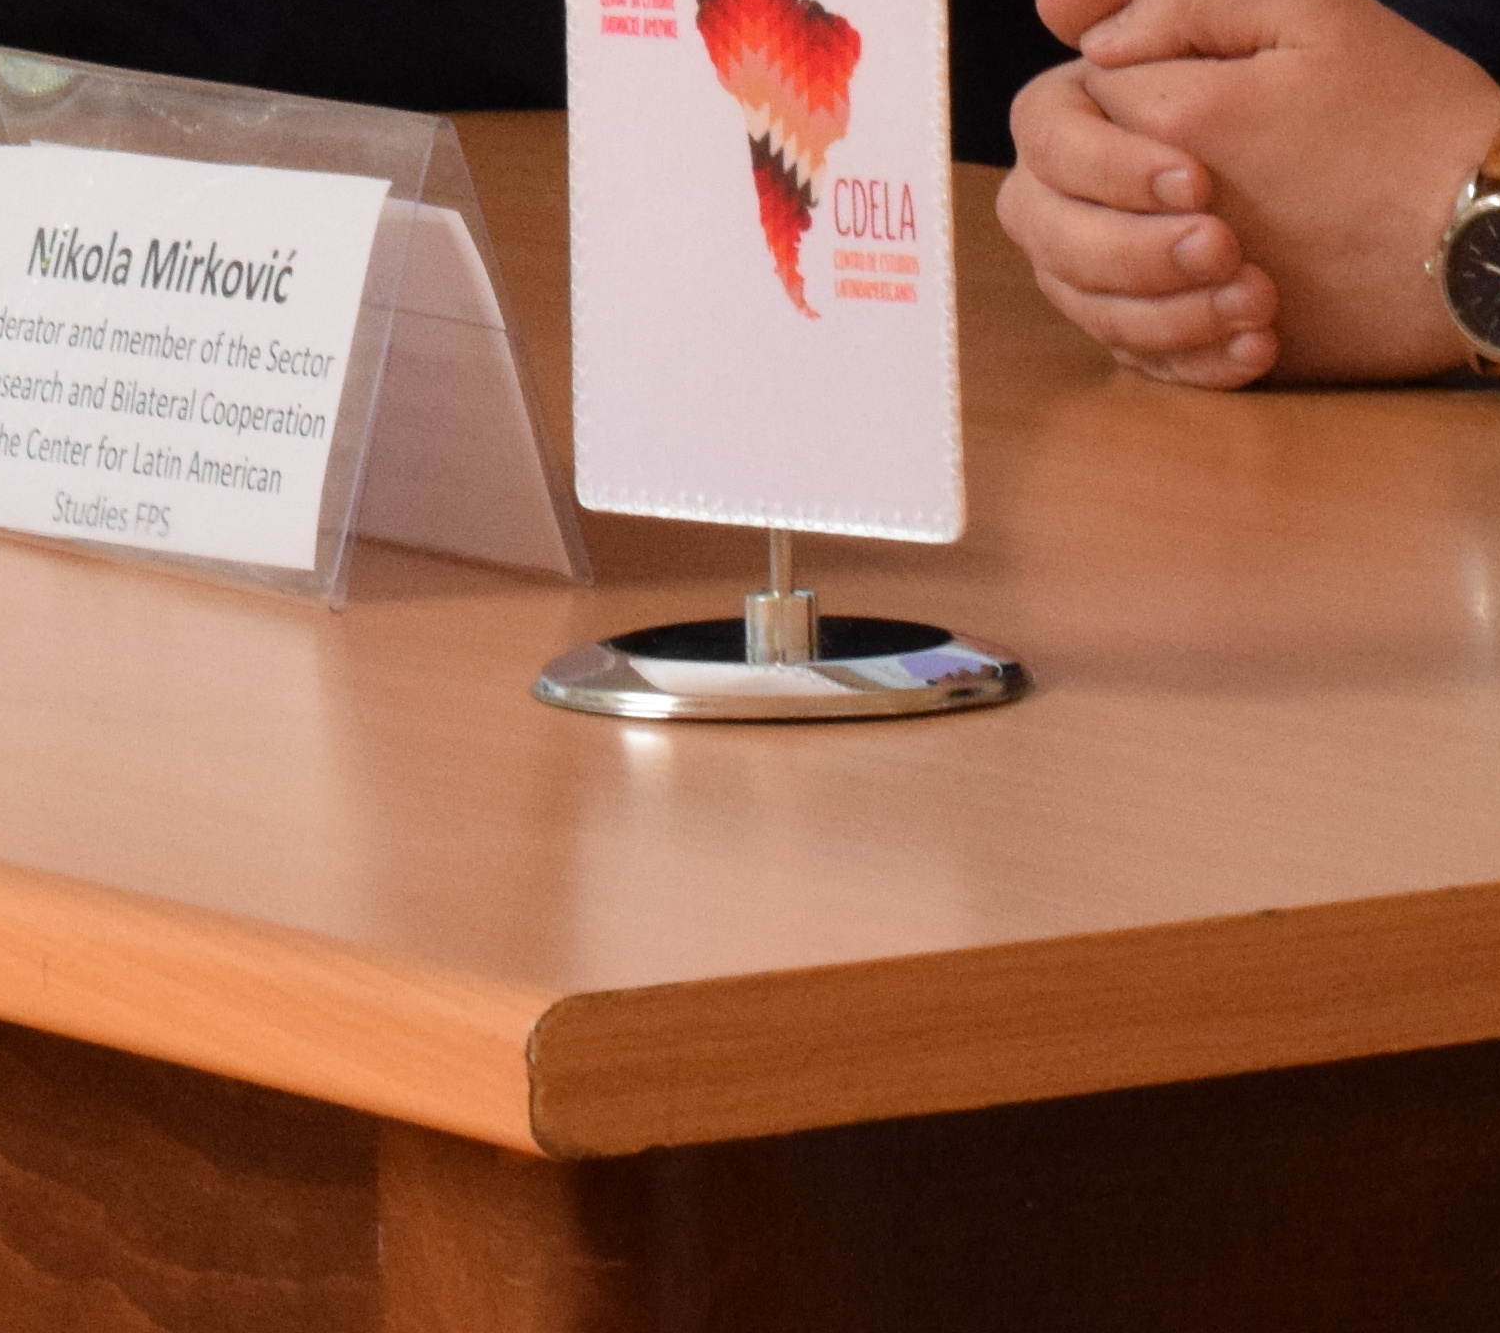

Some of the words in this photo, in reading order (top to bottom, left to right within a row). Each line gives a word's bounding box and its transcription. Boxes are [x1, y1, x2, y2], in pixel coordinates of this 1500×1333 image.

[835, 178, 917, 242] CDELA
[26, 227, 133, 287] Nikola
[140, 238, 297, 305] Mirković
[68, 317, 108, 351] and
[110, 325, 198, 363] member
[200, 330, 225, 365] of
[227, 334, 262, 371] the
[265, 339, 335, 380] Sector
[68, 375, 108, 410] and
[111, 378, 197, 422] Bilateral
[200, 391, 326, 439] Cooperation
[26, 428, 93, 467] Center
[97, 434, 129, 473] for
[132, 442, 183, 482] Latin
[186, 450, 282, 494] American
[52, 490, 129, 532] Studies
[134, 501, 171, 539] FPS
